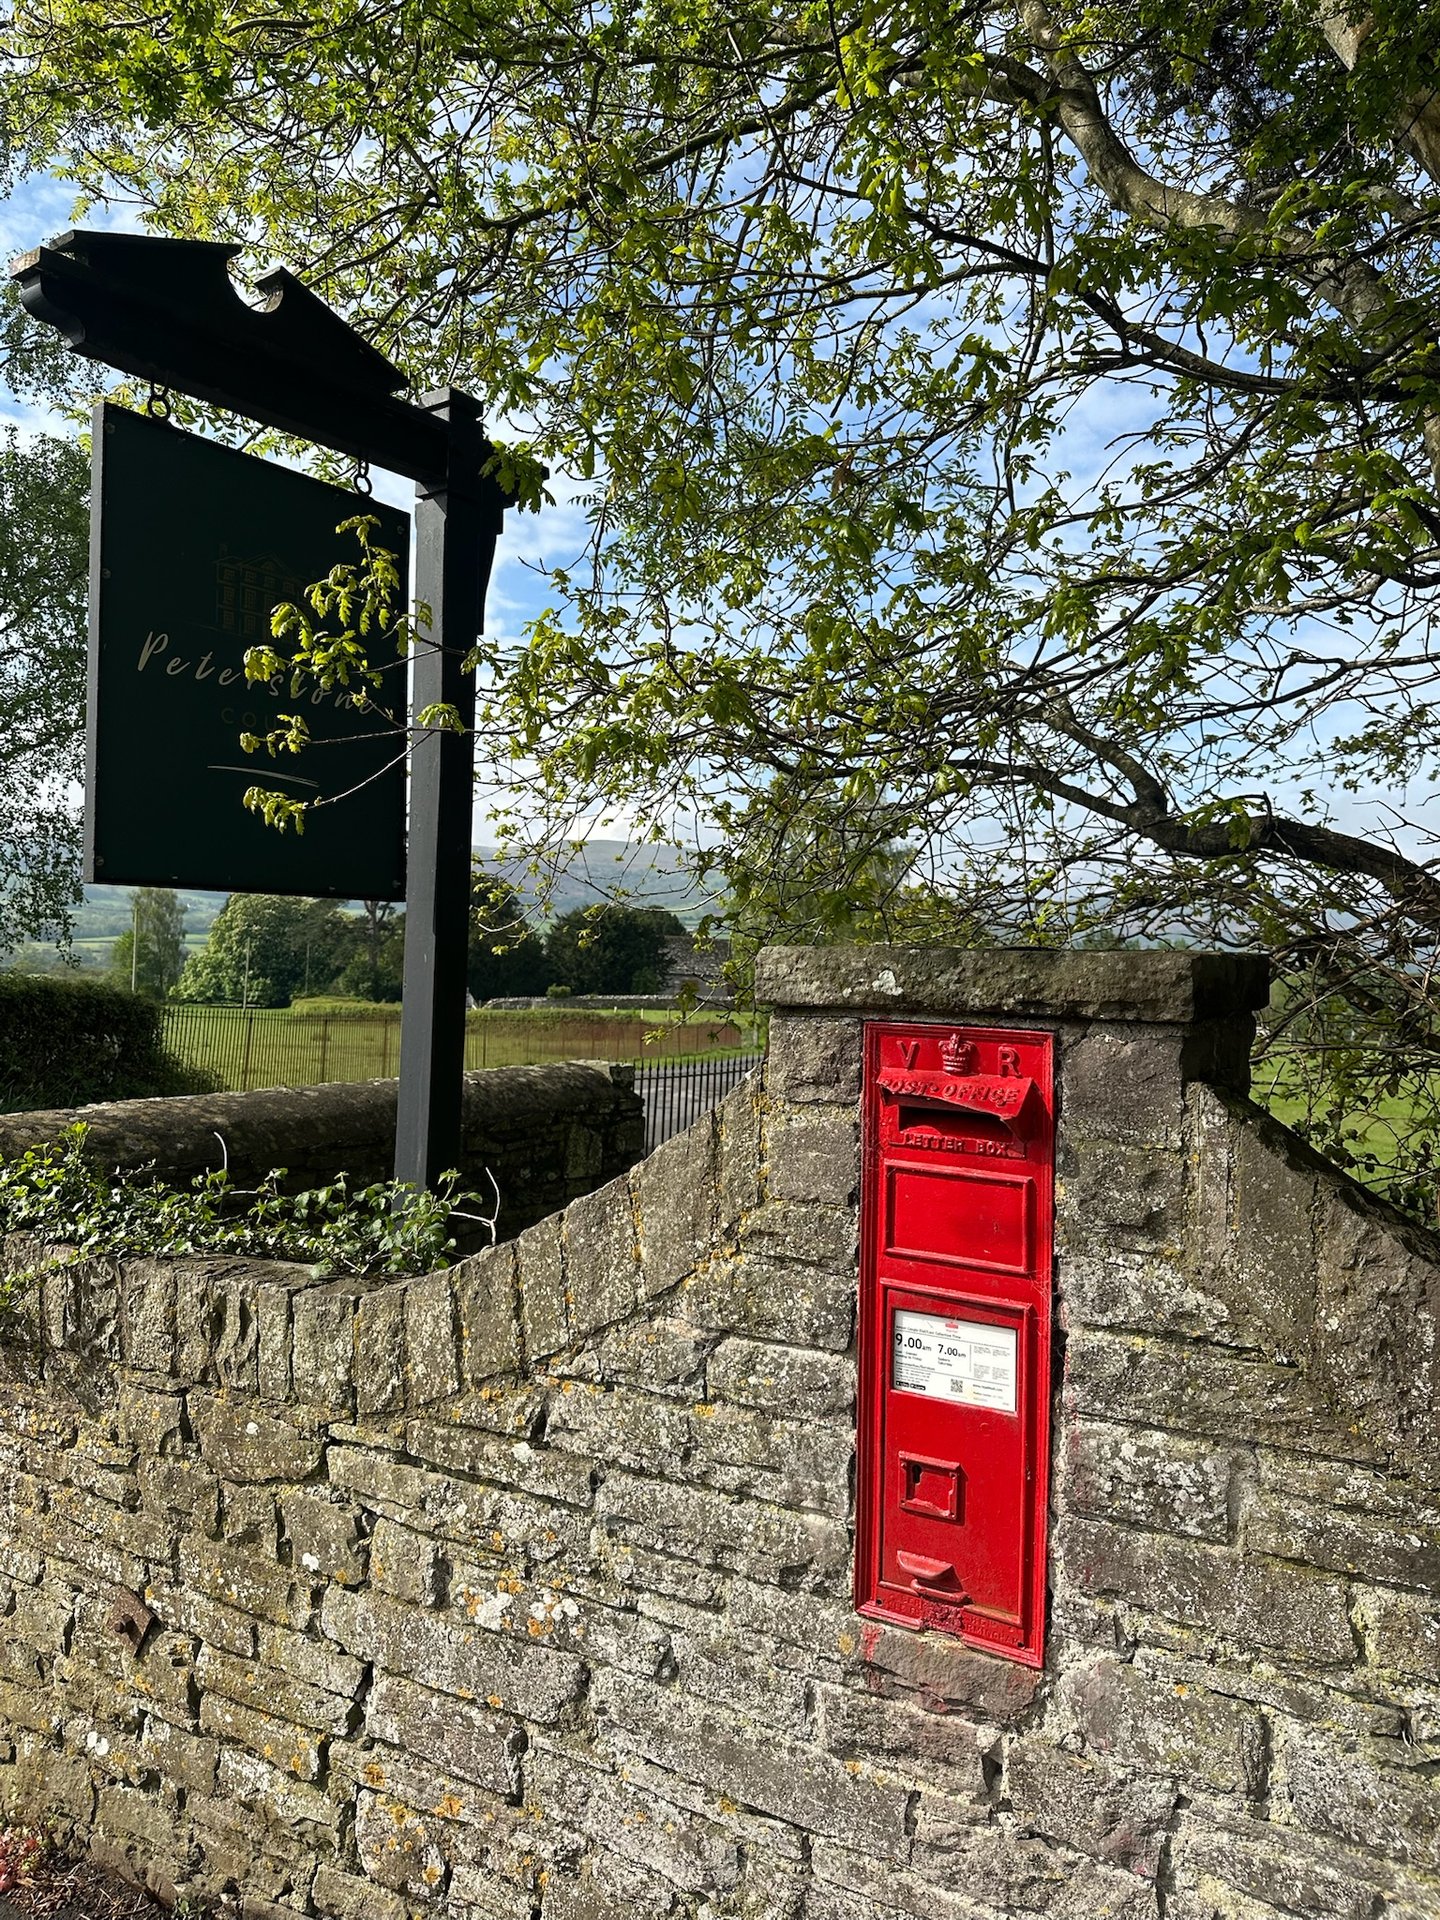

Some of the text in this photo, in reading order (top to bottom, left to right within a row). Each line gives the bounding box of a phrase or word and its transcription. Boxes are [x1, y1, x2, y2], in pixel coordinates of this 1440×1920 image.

[896, 1040, 1023, 1078] V R
[904, 1132, 1009, 1156] LETTER BOX
